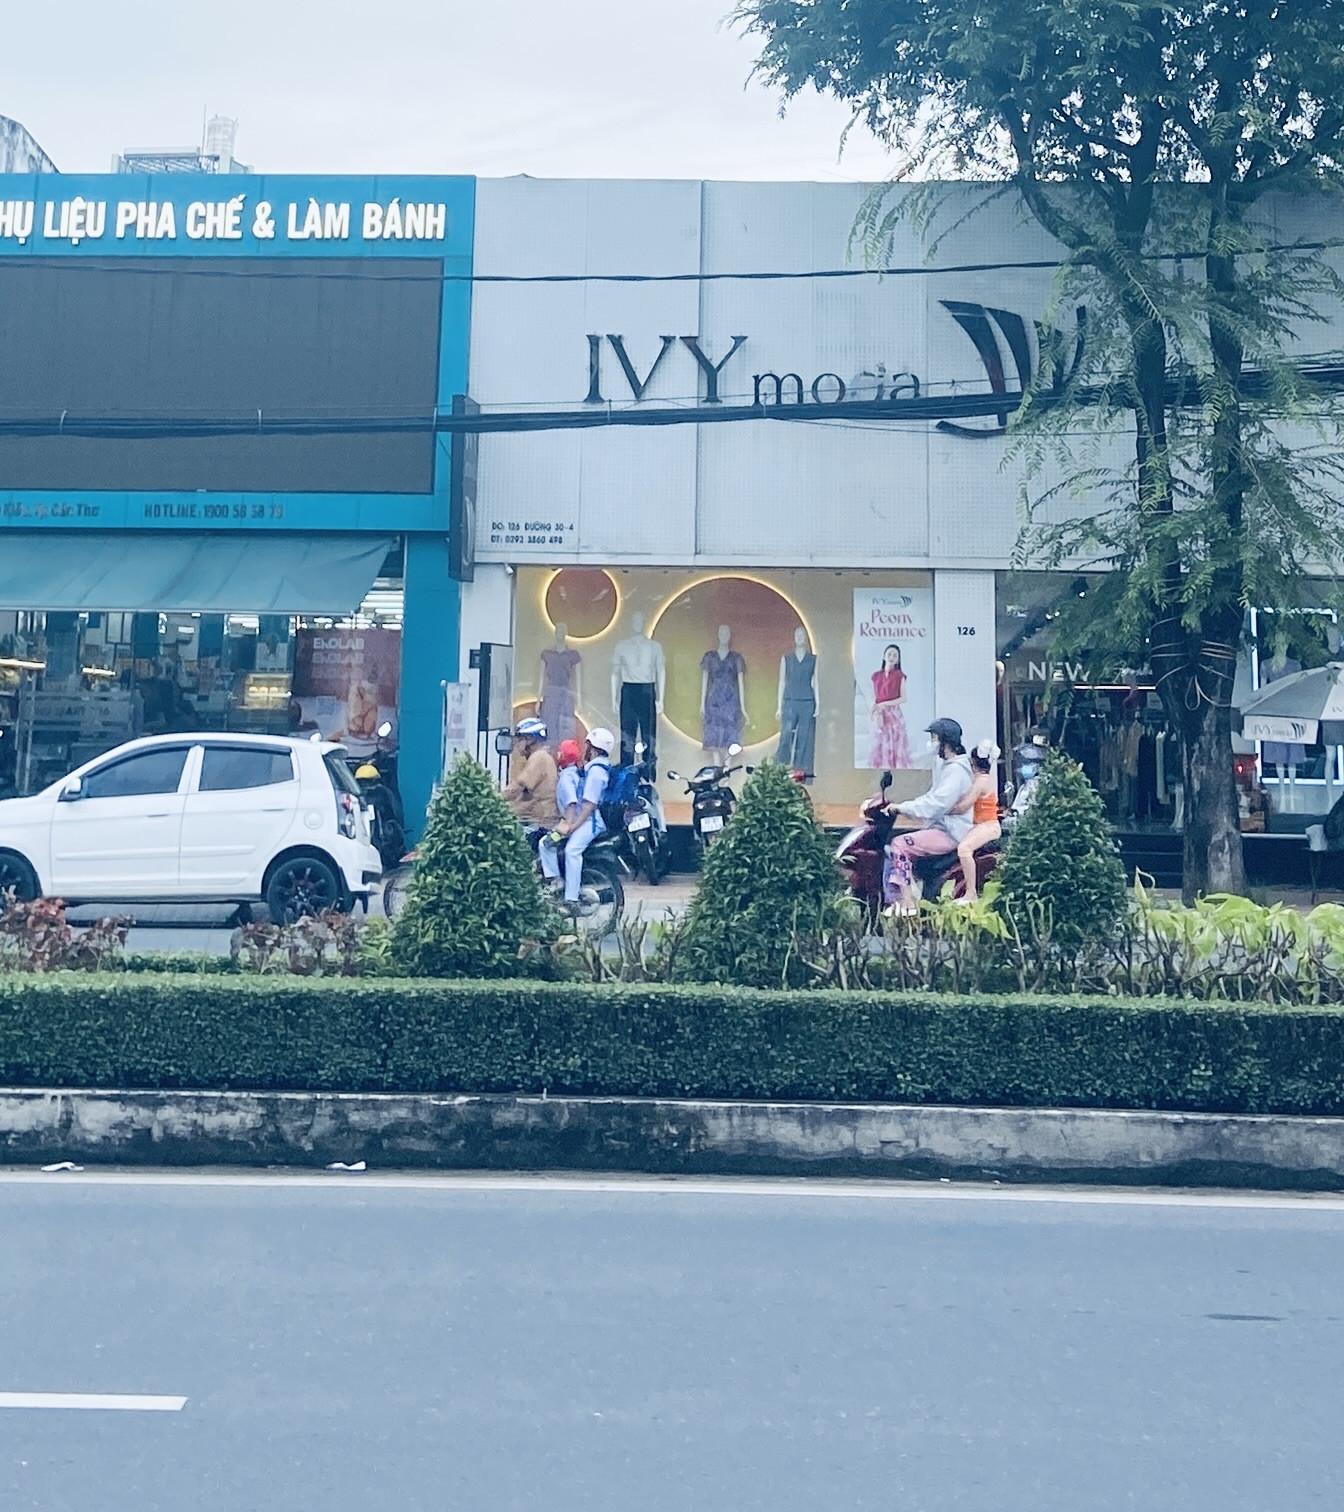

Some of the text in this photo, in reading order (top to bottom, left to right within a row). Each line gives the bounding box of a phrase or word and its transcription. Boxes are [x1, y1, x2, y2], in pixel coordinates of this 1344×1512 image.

[43, 196, 106, 245] LIỆU
[115, 201, 177, 239] PHA
[186, 194, 246, 239] CHẾ
[252, 201, 275, 238] &
[287, 197, 350, 239] LÀM
[363, 197, 446, 239] BÁNH
[584, 333, 749, 404] IVY
[859, 622, 927, 638] Romance
[957, 626, 976, 636] 126
[1029, 661, 1090, 682] NEW
